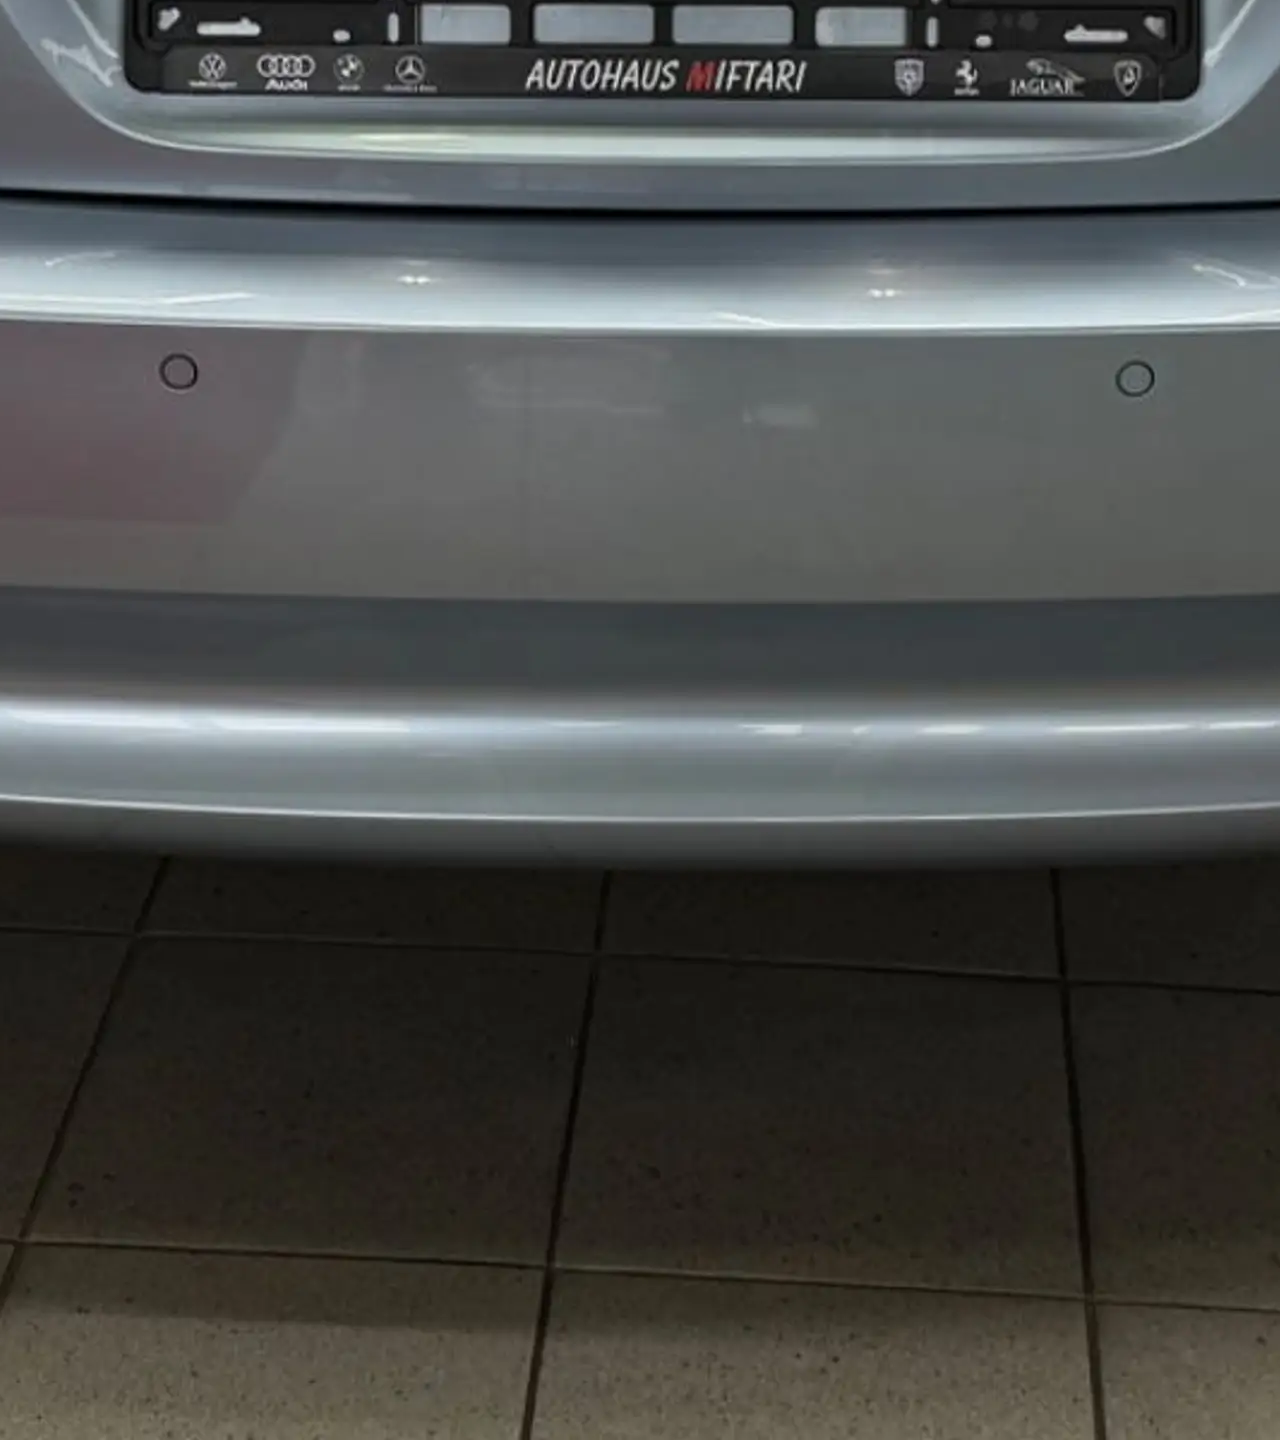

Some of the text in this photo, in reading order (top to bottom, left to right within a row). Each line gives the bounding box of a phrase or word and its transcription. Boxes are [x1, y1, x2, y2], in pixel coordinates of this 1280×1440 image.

[265, 78, 308, 92] Audi
[525, 58, 808, 92] AUTOHAUS MIFTARI
[1009, 77, 1082, 97] JAGUAR
